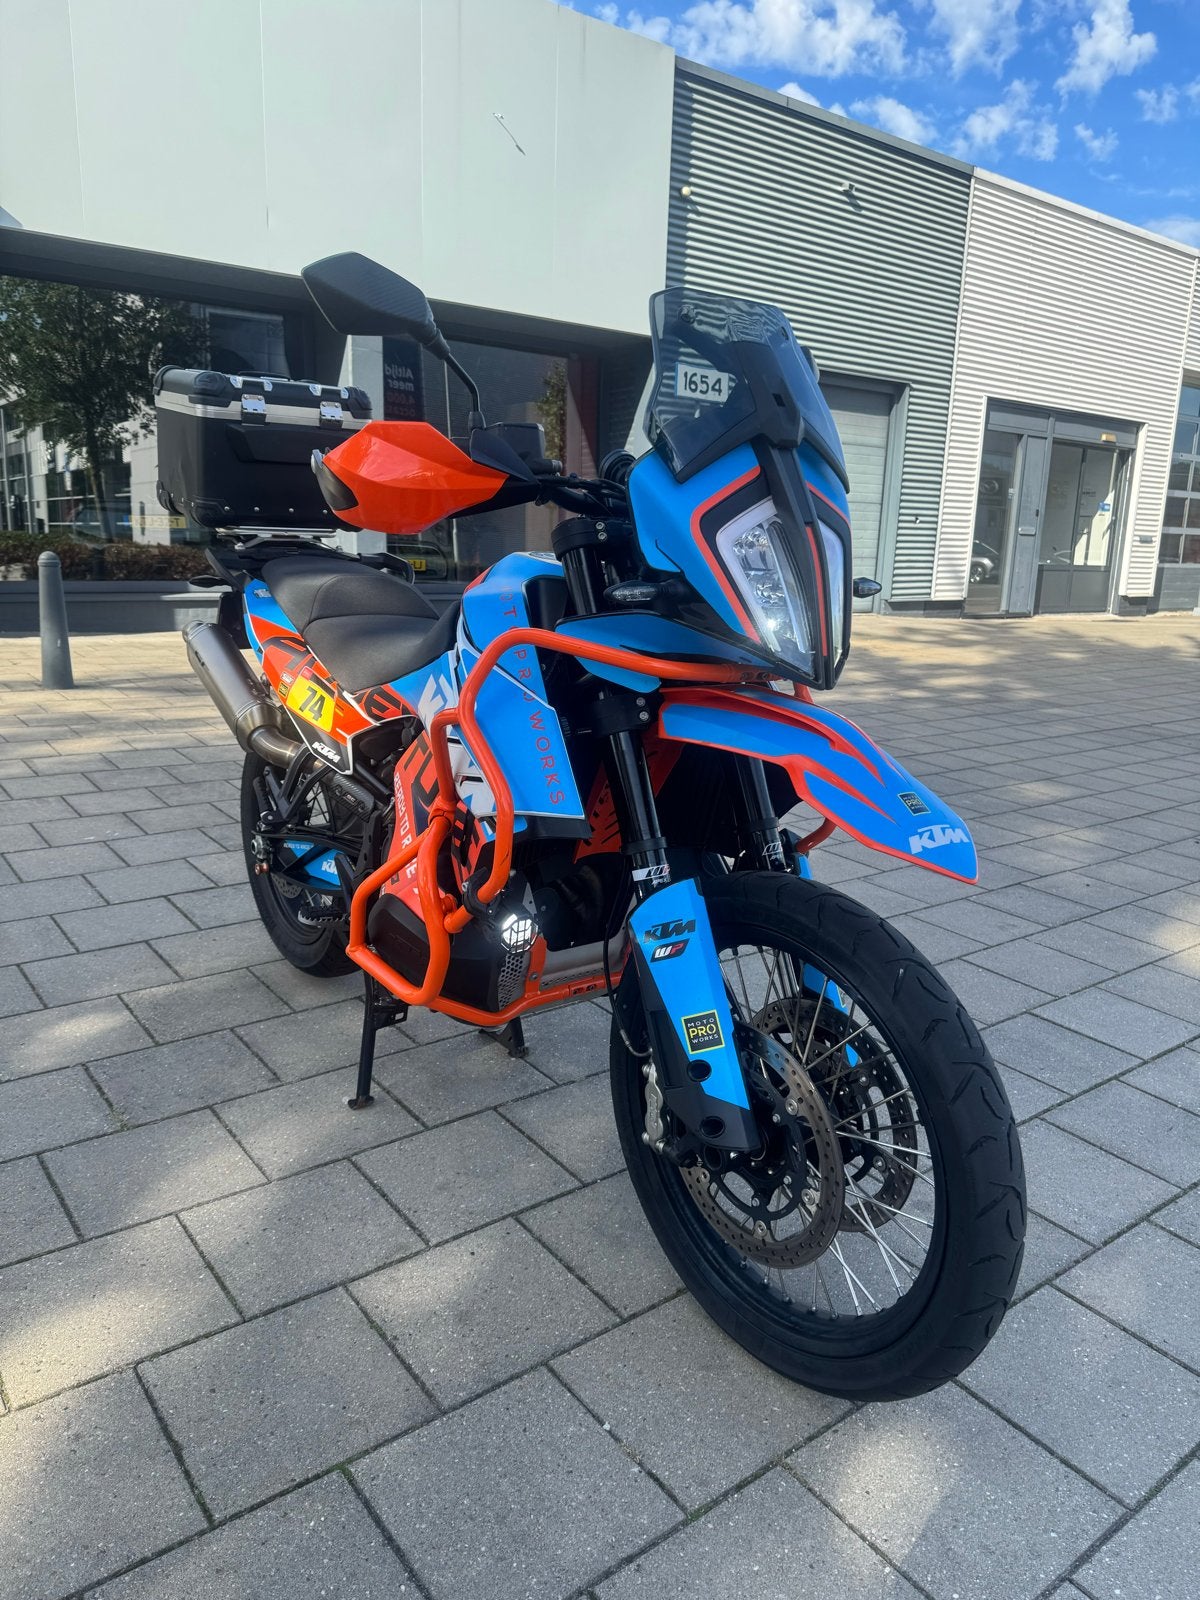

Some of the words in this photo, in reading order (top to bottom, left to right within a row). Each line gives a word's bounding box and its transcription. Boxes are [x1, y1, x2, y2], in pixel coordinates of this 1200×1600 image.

[683, 371, 722, 397] 1654
[299, 685, 326, 722] 74
[312, 741, 342, 764] KTM
[529, 710, 565, 805] WORKS
[400, 812, 410, 836] TO
[909, 824, 970, 855] KTM
[643, 919, 697, 944] KTM
[654, 942, 685, 959] WP
[687, 1017, 715, 1028] MOTO
[689, 1023, 716, 1039] PRO
[691, 1033, 719, 1044] WORKS
